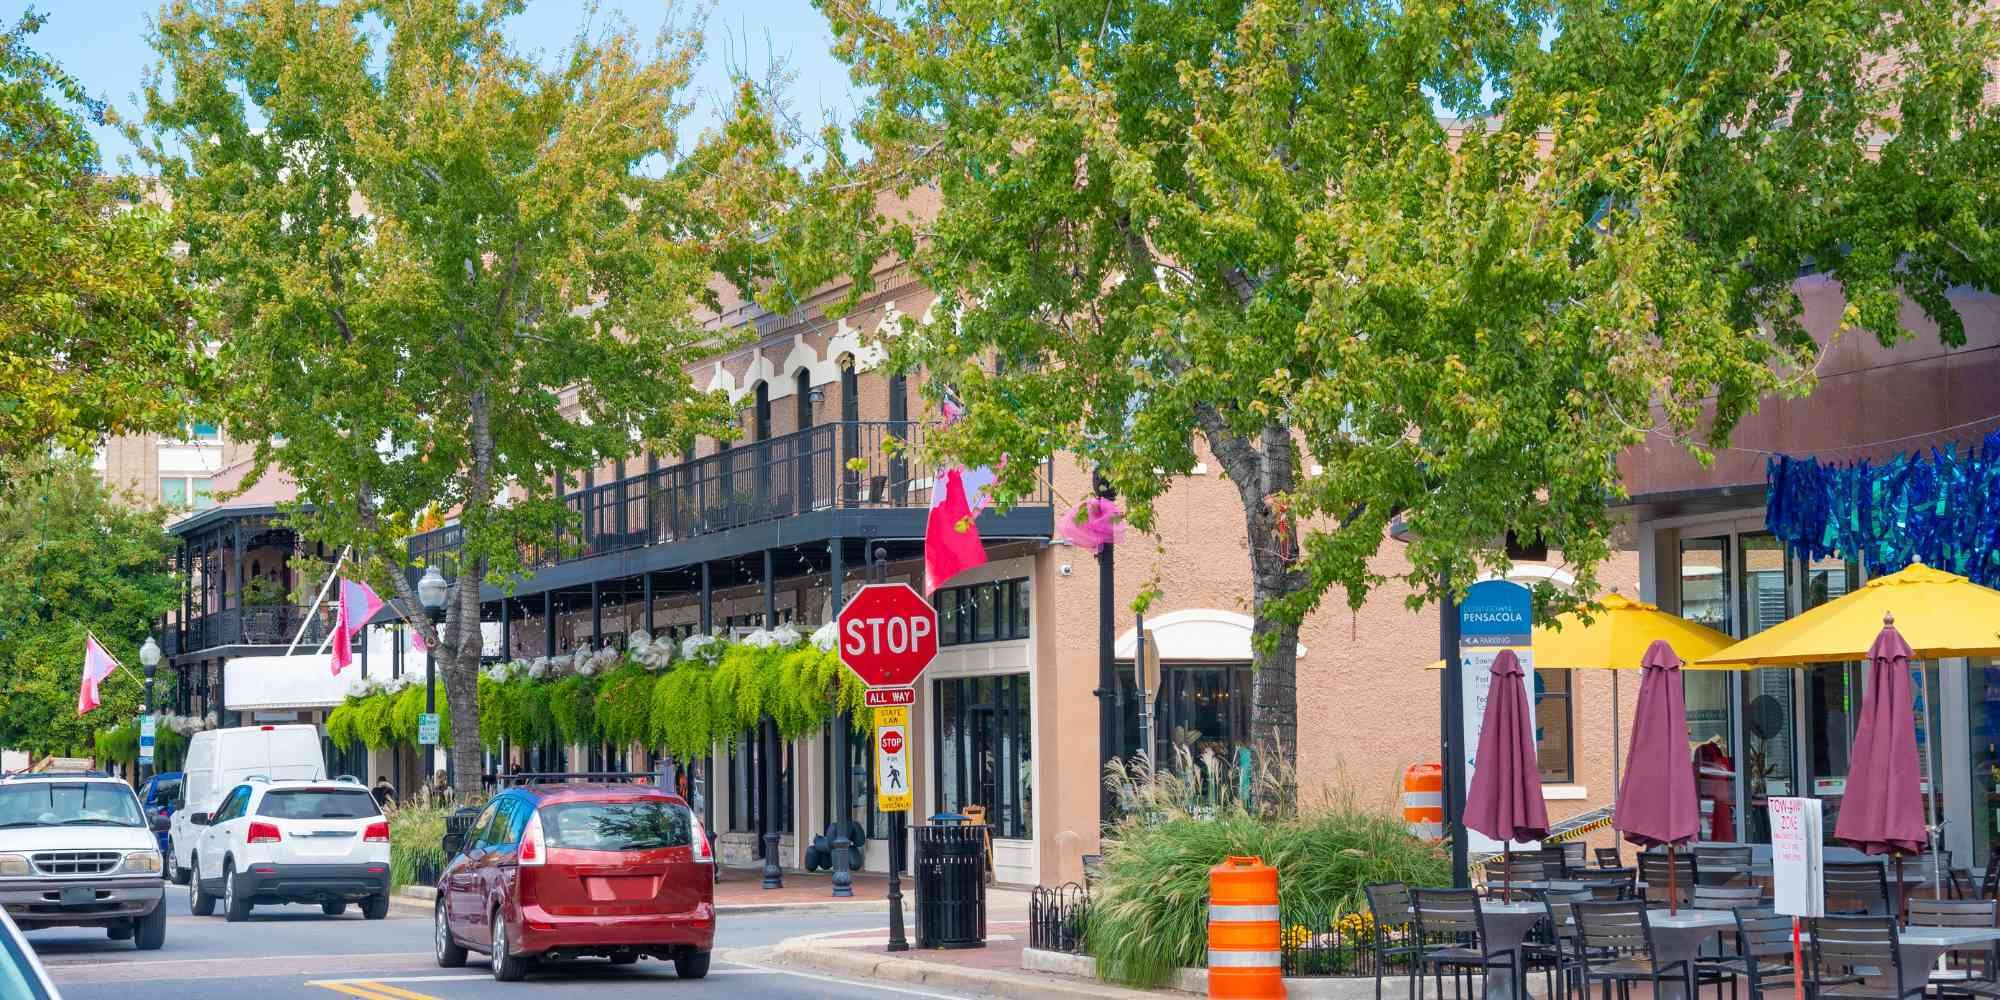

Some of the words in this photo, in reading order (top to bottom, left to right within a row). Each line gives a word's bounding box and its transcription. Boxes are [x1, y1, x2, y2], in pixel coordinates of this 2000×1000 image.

[1463, 612, 1522, 622] PENSACOLA
[845, 616, 931, 656] STOP
[870, 693, 887, 704] ALL
[892, 691, 911, 703] WAY
[881, 737, 902, 748] STOP
